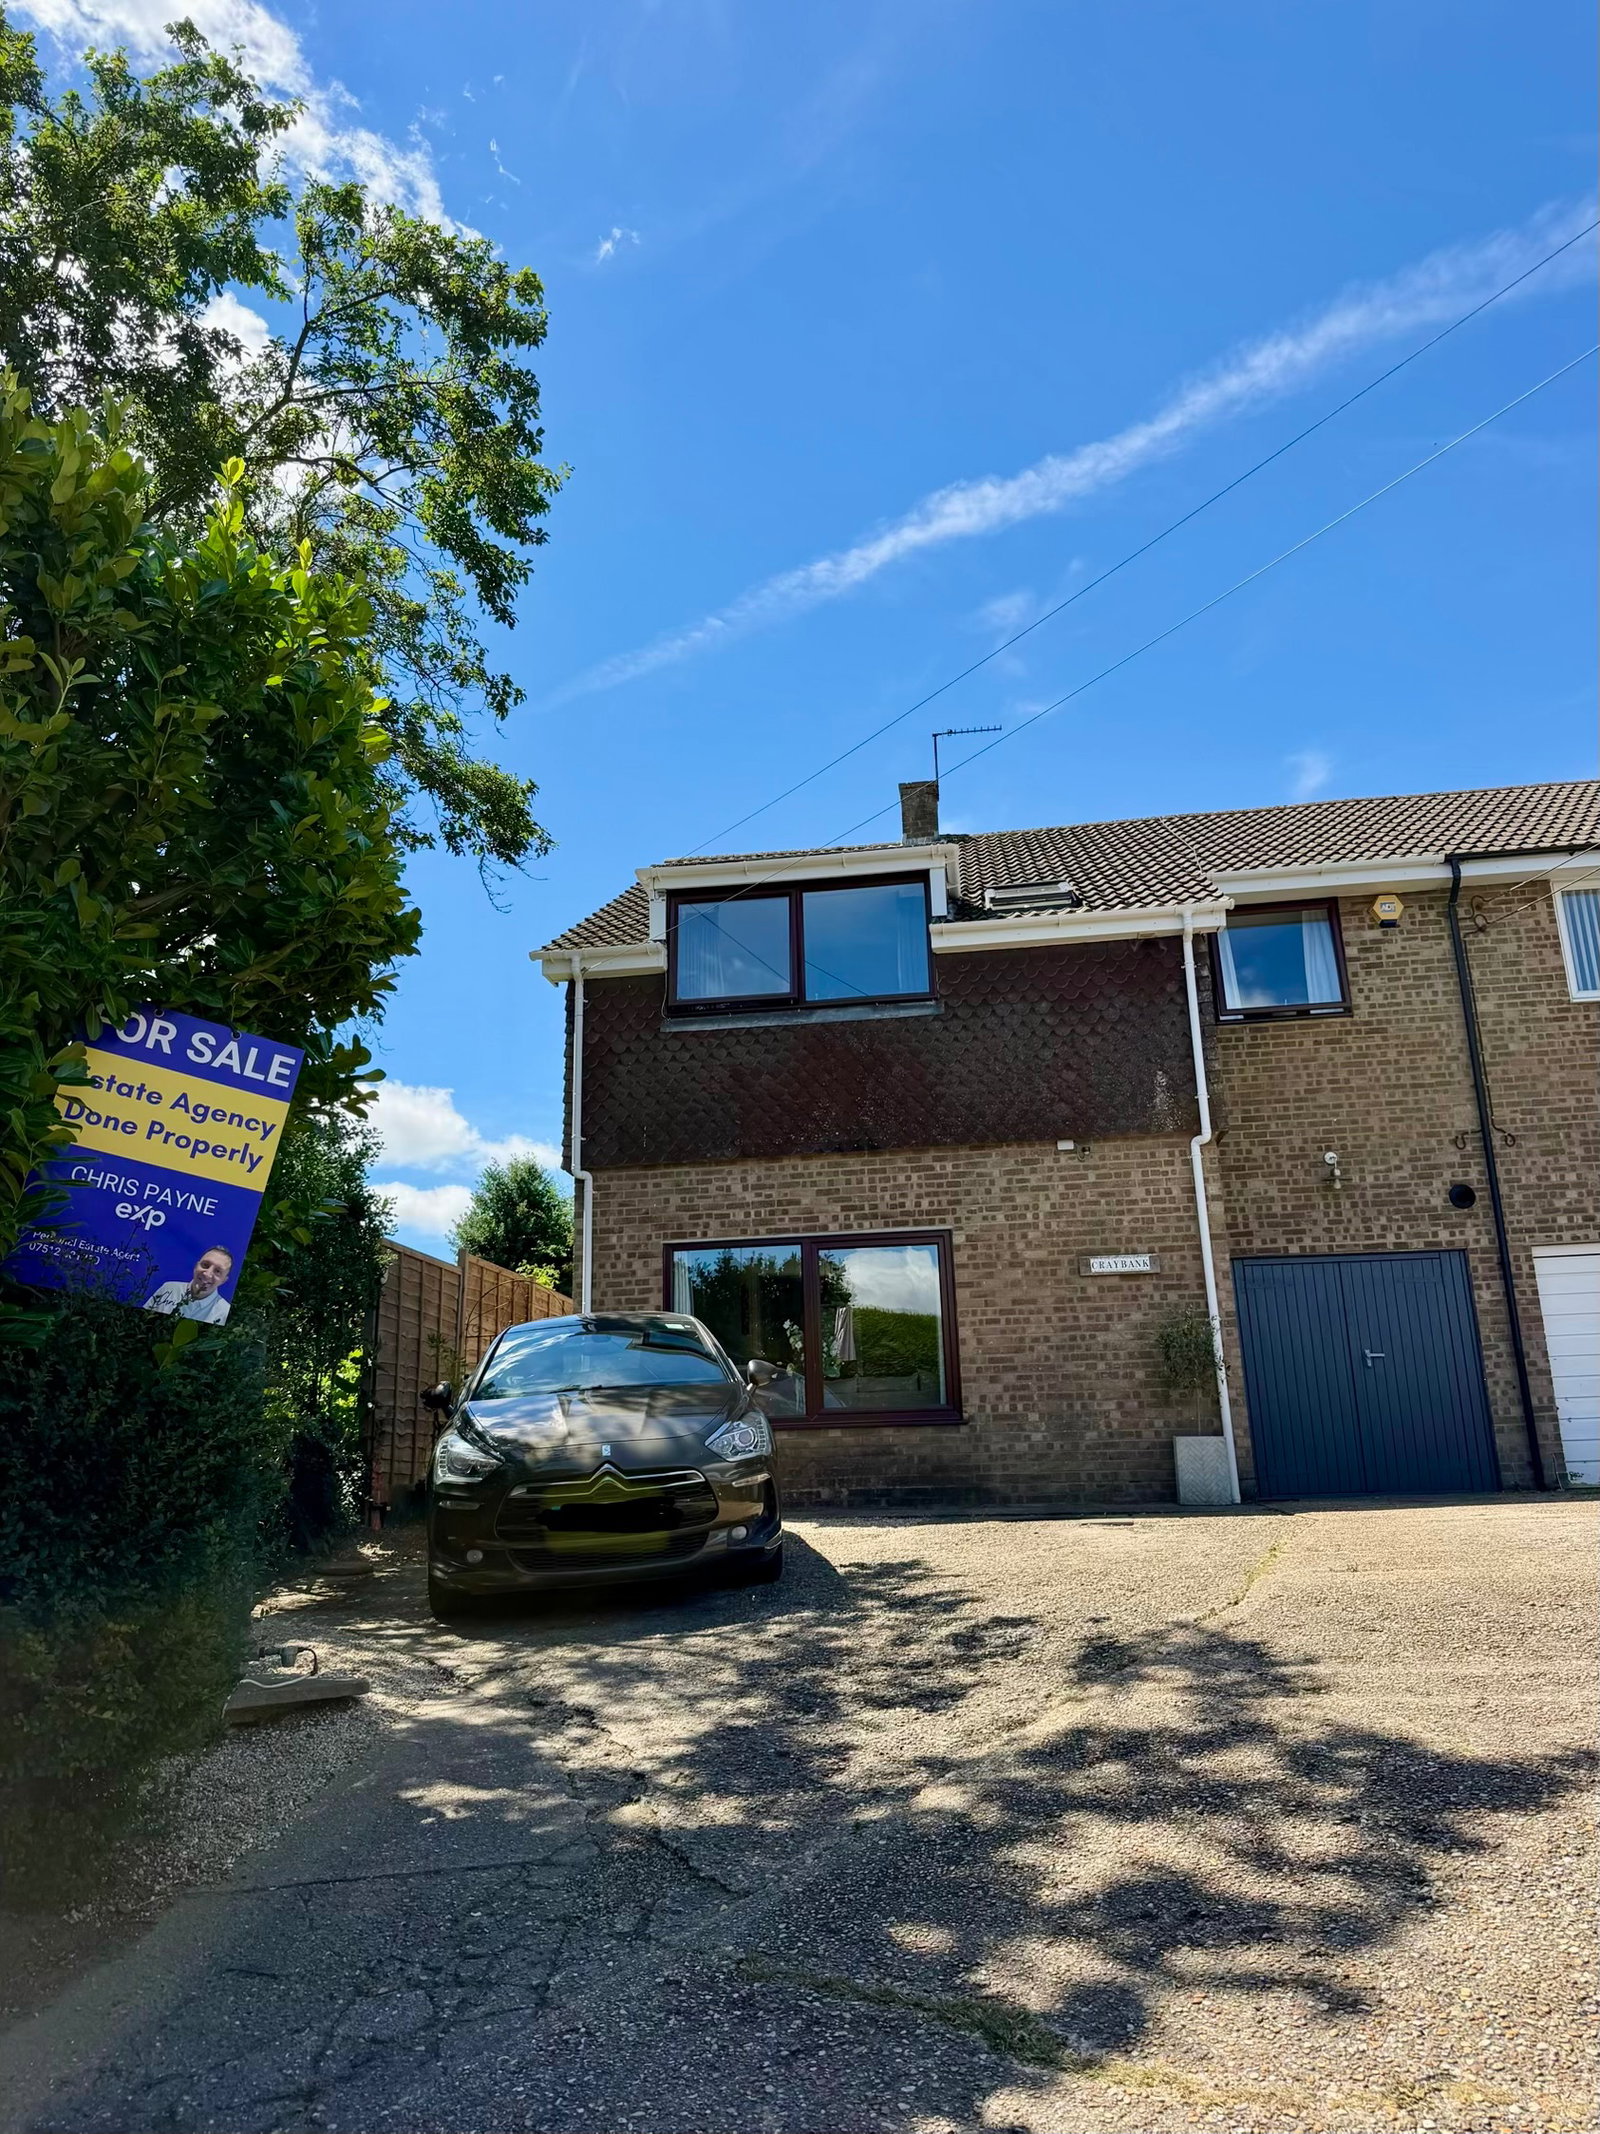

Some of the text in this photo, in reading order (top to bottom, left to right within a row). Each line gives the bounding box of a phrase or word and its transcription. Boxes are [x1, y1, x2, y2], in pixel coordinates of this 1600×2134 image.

[100, 1010, 296, 1088] OR SALE
[64, 1101, 264, 1173] Done Properly
[87, 1066, 277, 1141] state Agency
[71, 1166, 219, 1216] CHRIS PAYNE
[1091, 1259, 1149, 1270] CRAYBANK
